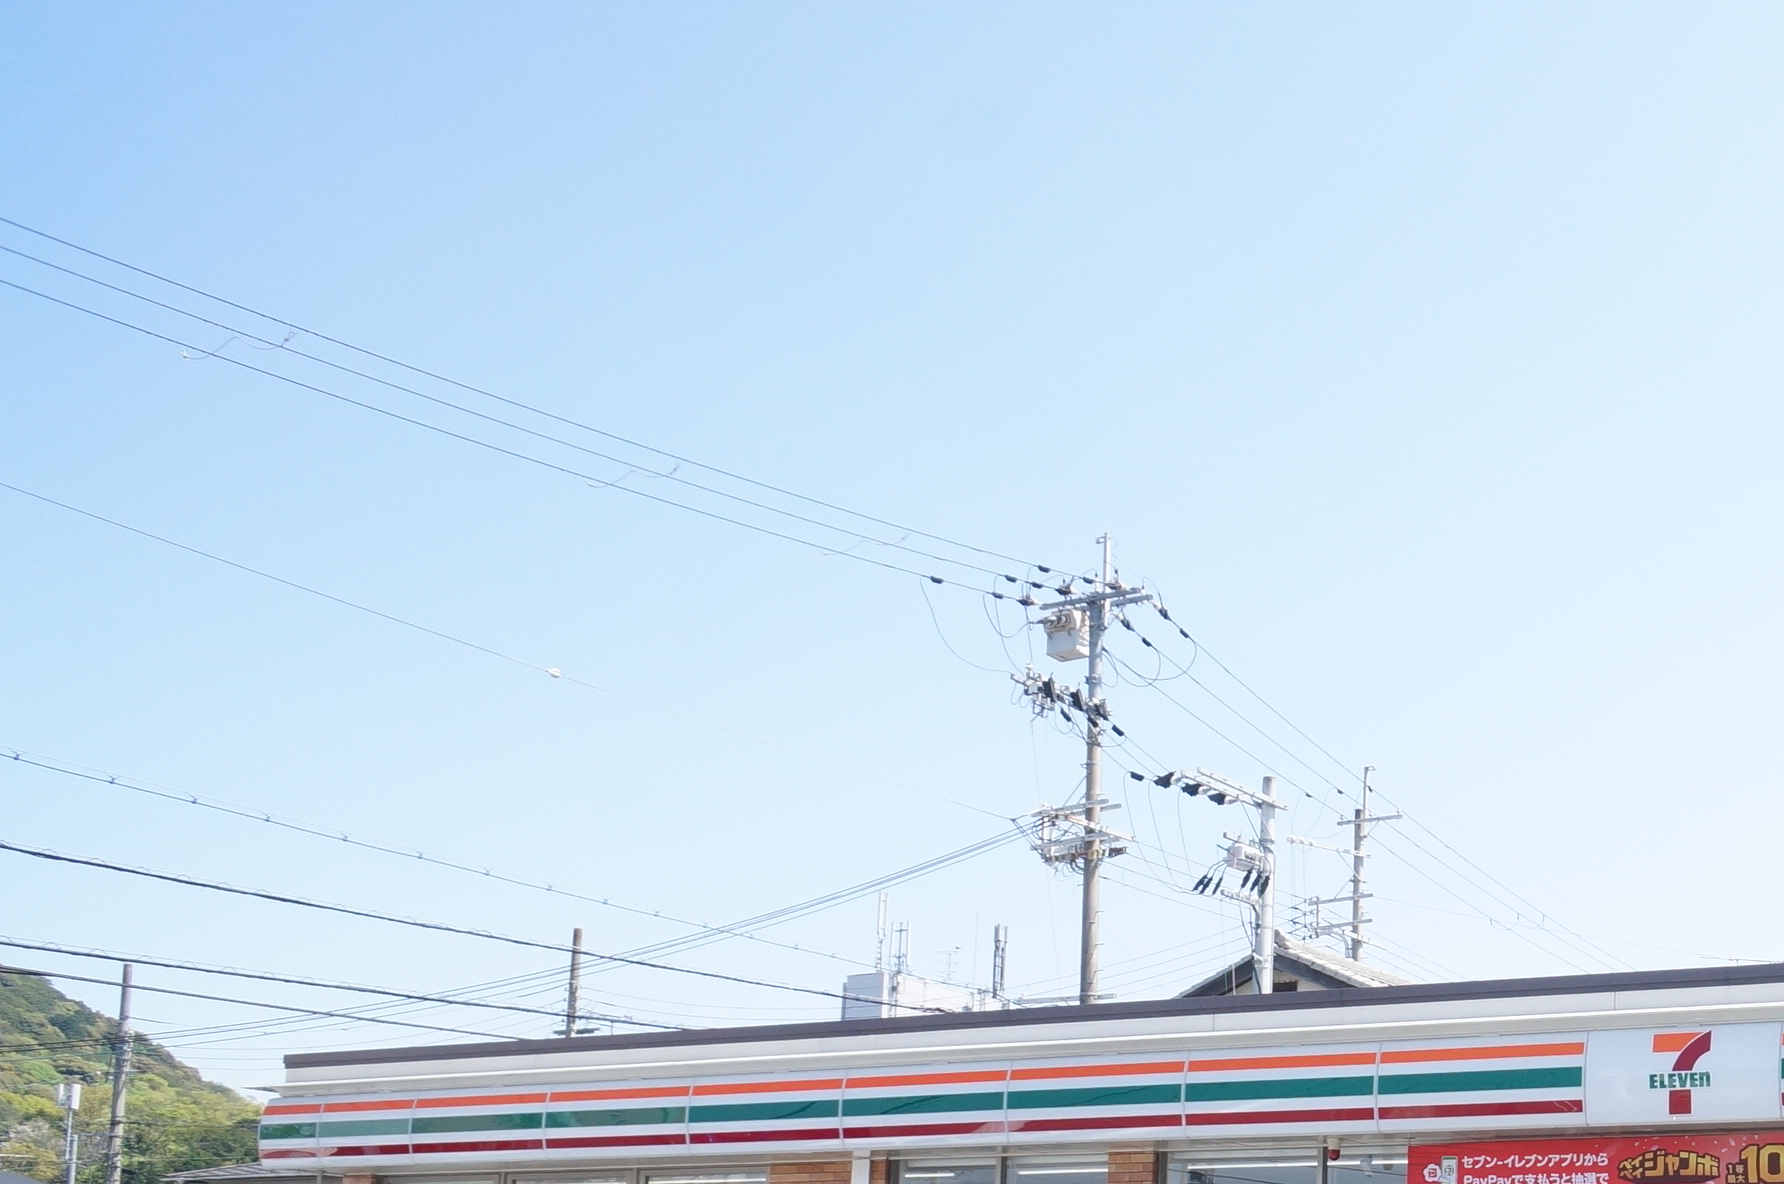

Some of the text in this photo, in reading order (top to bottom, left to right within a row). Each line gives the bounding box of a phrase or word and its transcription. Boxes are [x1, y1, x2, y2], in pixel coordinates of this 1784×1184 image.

[1461, 1152, 1609, 1169] セブン-イレブンアプリから
